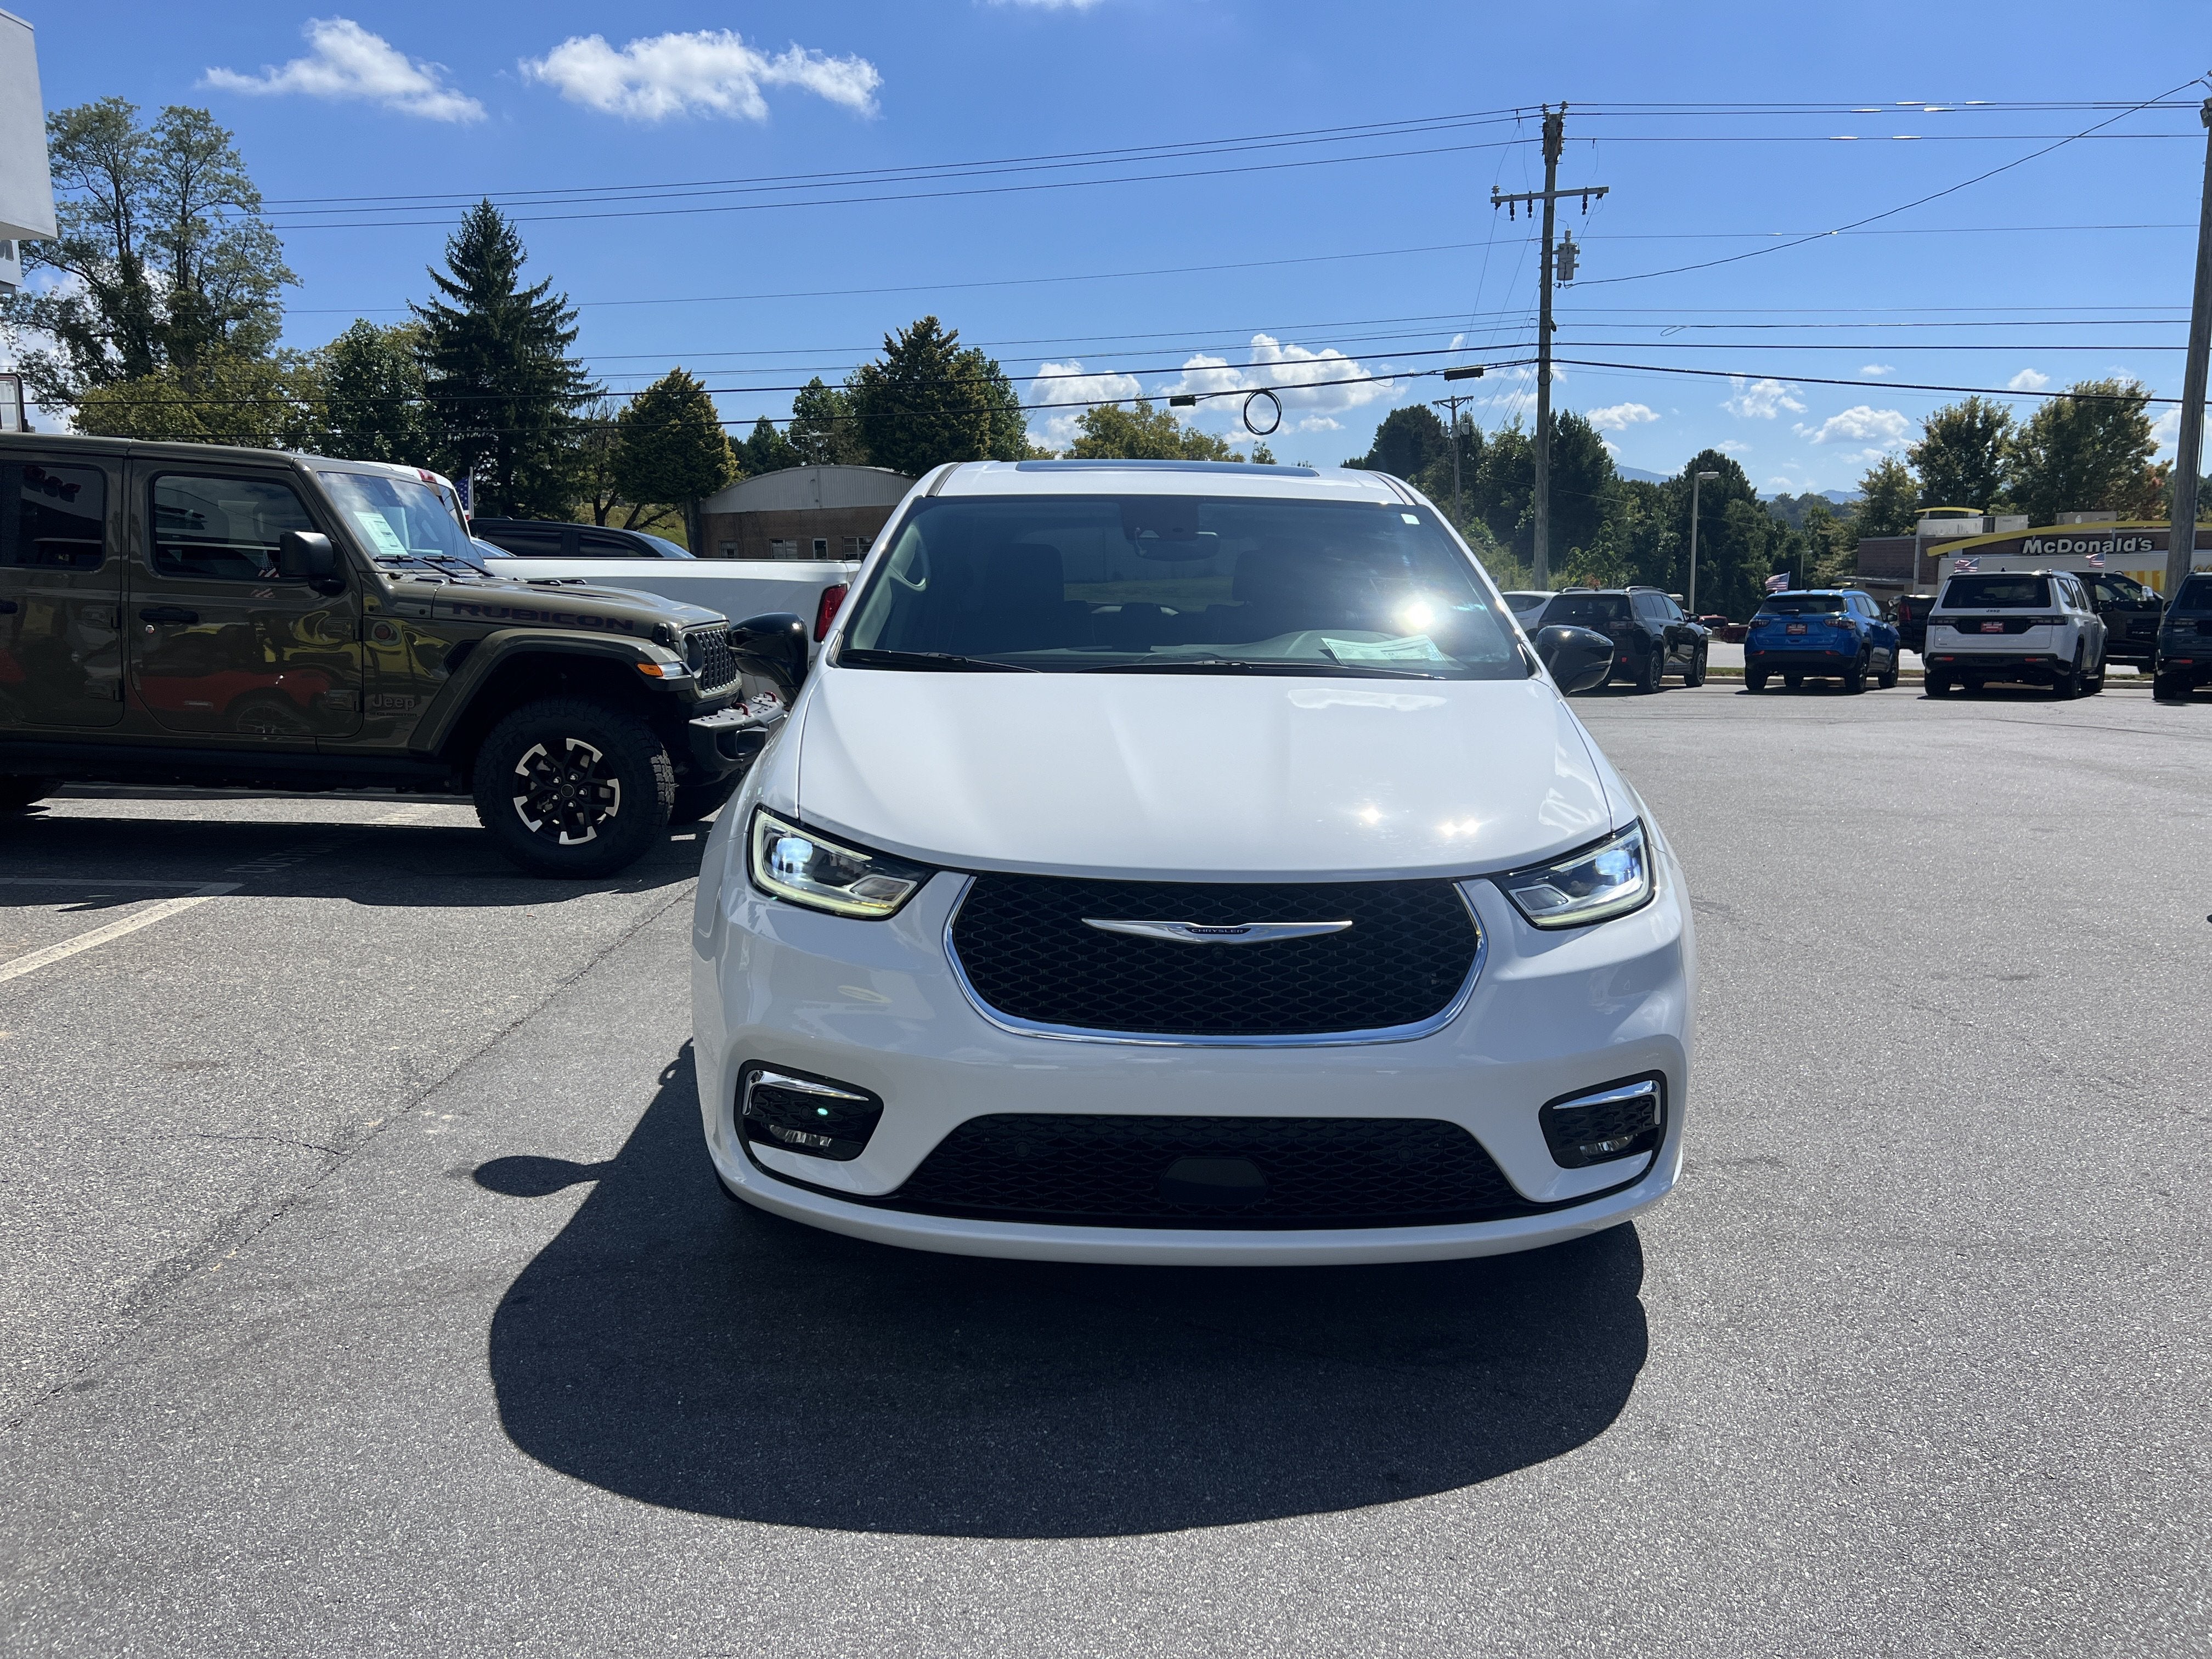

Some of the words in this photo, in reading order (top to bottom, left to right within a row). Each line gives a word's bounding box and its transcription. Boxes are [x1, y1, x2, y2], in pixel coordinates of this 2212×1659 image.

[2022, 537, 2152, 554] McDonald's
[453, 603, 634, 630] RUBICON
[373, 693, 415, 711] Jeep
